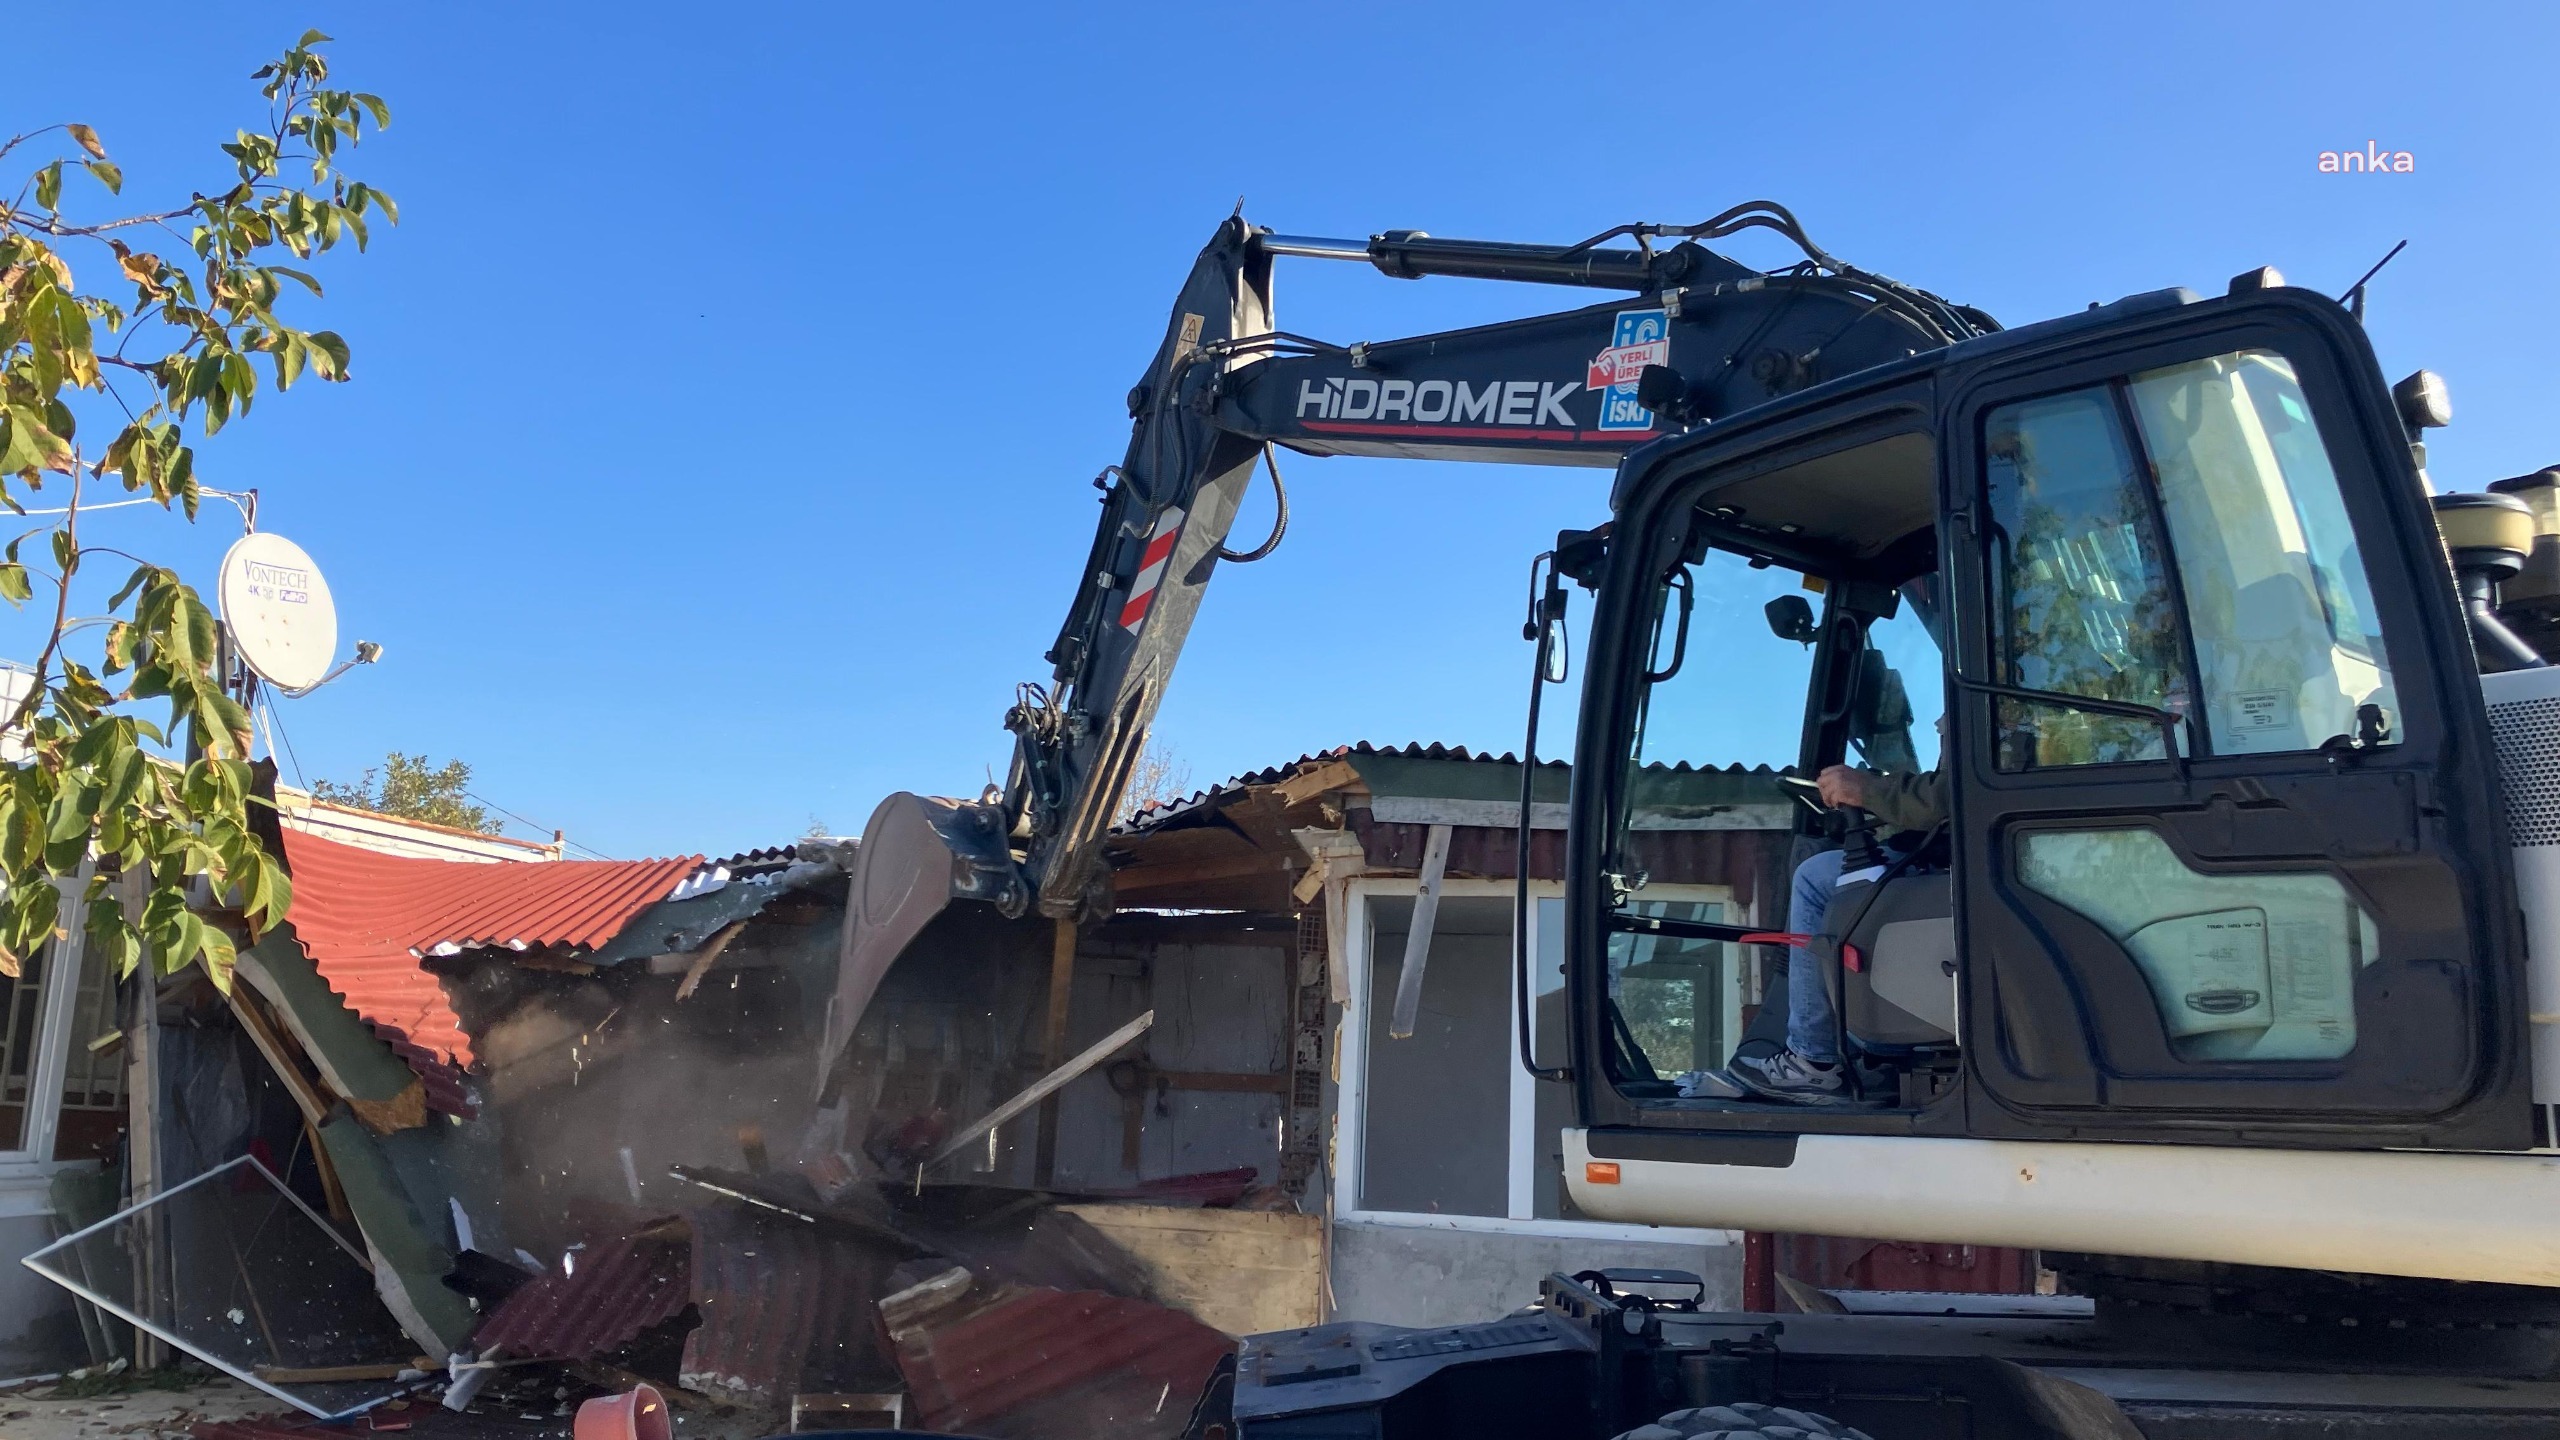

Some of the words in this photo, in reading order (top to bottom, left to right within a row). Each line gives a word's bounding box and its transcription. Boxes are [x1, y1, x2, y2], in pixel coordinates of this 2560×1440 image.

[1296, 377, 1583, 426] HİDROMEK
[244, 559, 308, 590] VONTECH
[247, 584, 261, 598] 4K
